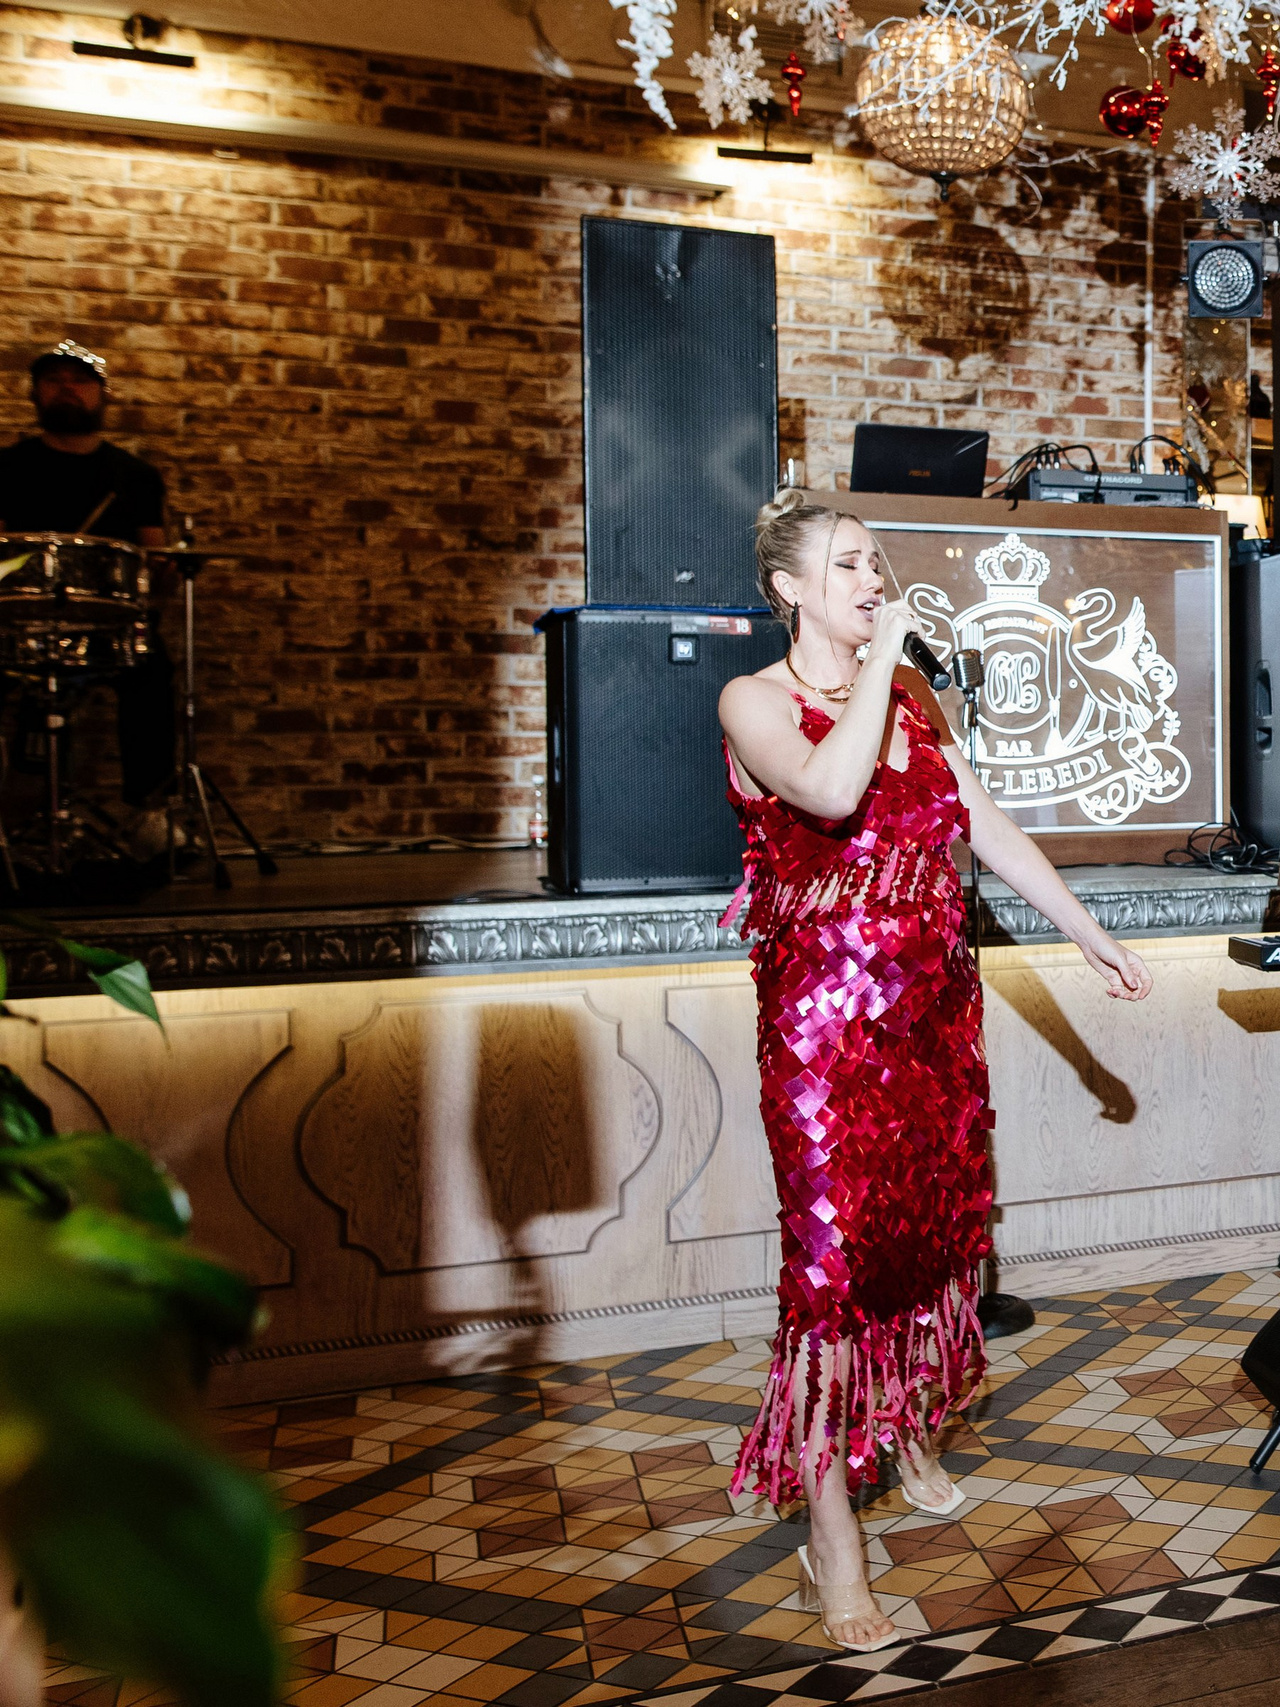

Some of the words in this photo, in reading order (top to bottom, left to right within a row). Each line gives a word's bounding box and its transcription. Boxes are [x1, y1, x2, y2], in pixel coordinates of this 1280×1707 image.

[735, 618, 750, 633] 18
[995, 740, 1034, 757] BAR
[975, 748, 1113, 795] I-LEBEDI
